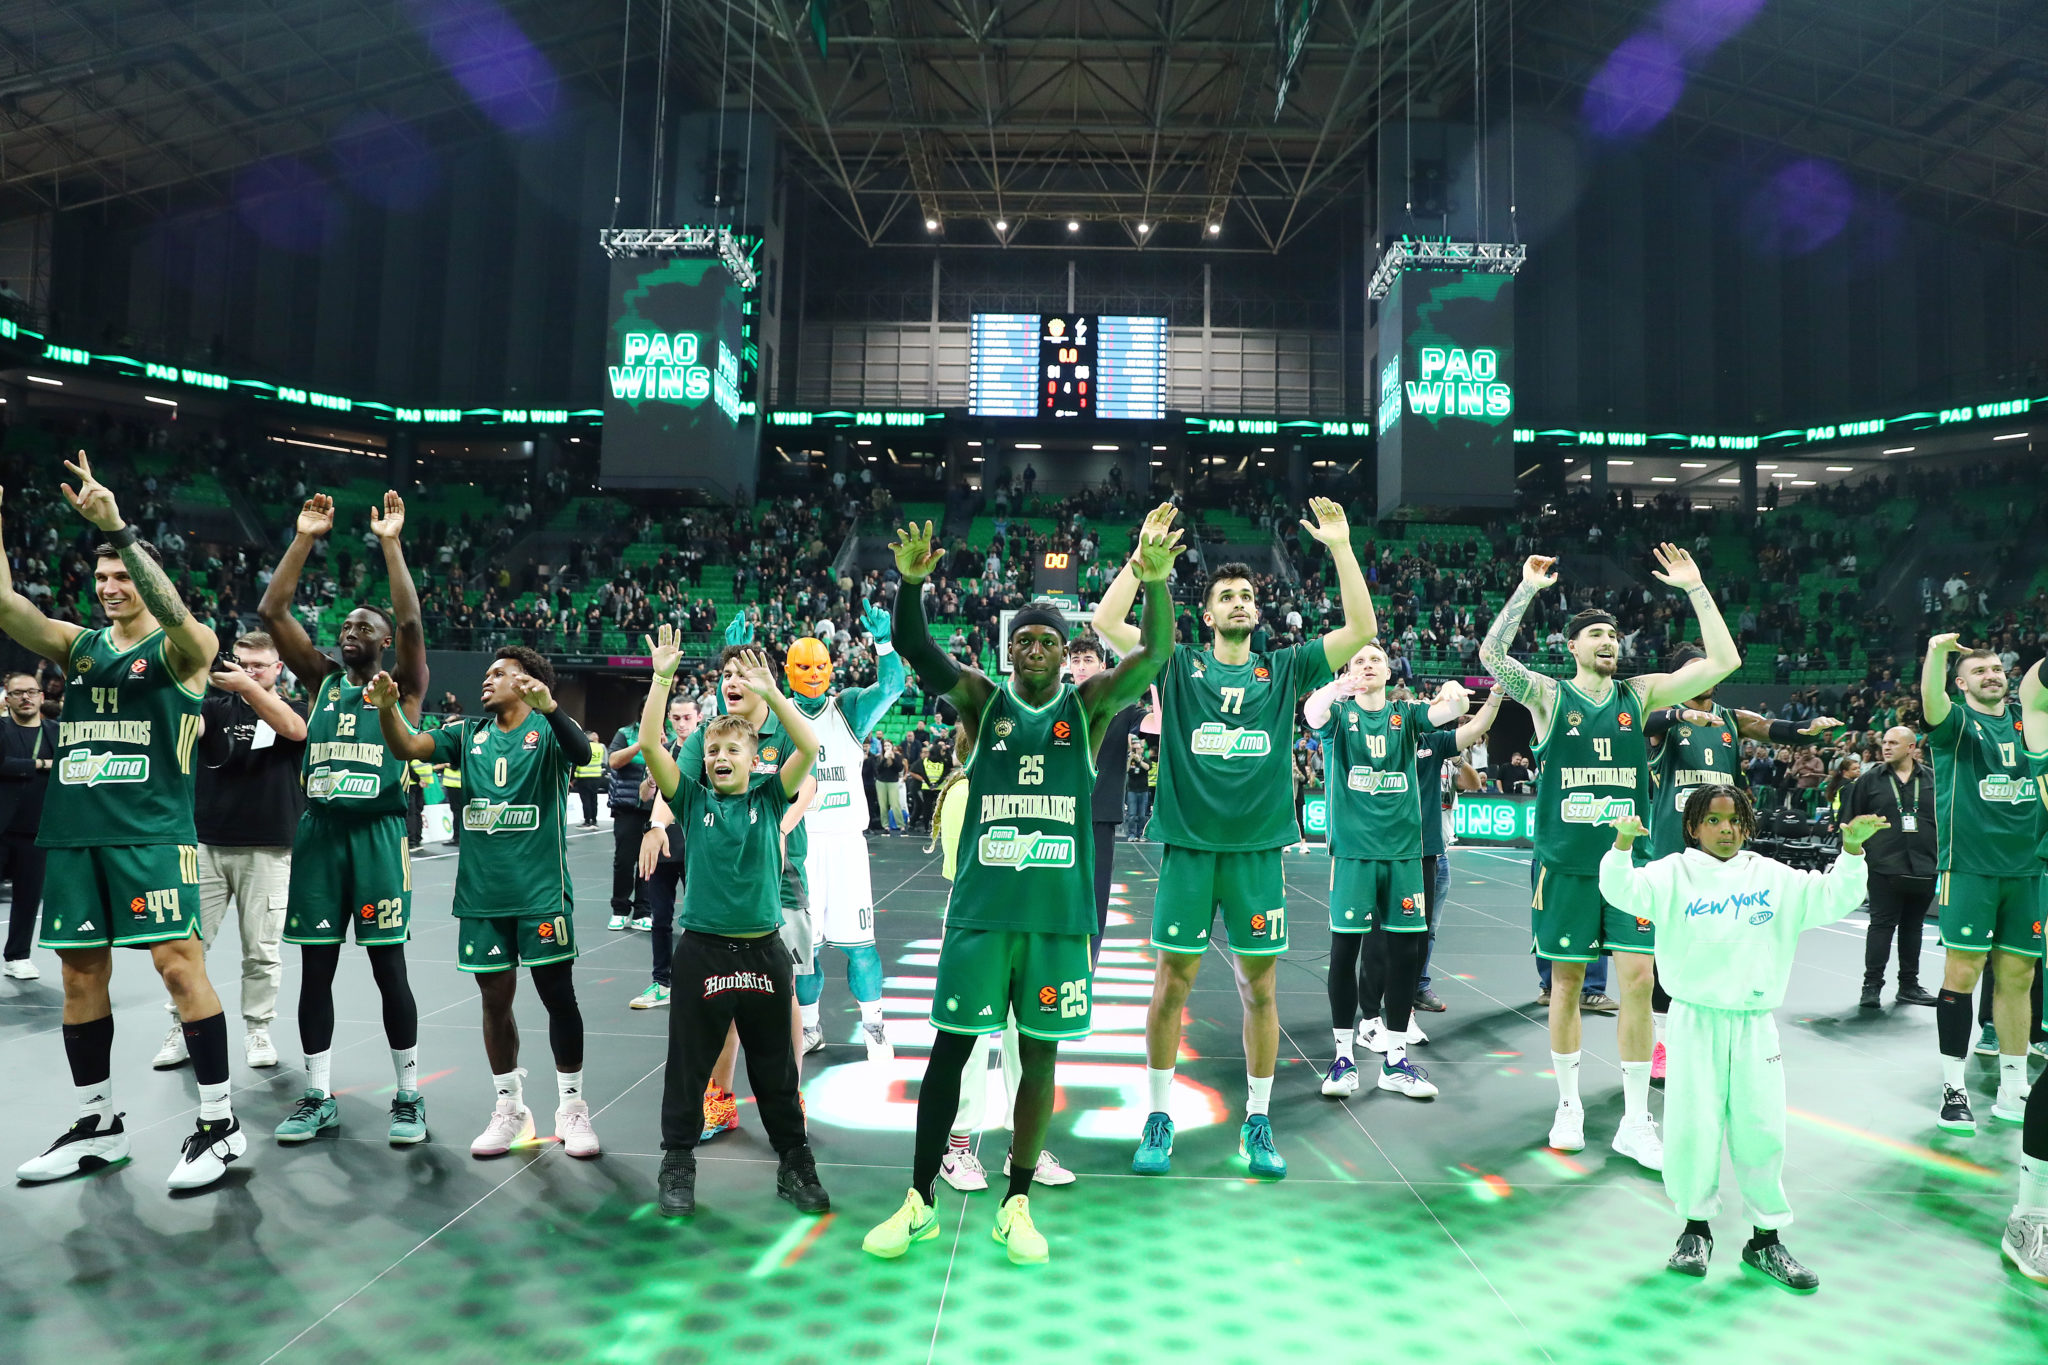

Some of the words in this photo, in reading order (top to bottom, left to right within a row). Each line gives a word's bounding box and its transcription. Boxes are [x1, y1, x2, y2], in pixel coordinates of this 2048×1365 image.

[625, 333, 698, 366] PAO
[145, 363, 178, 381] PAO
[1422, 348, 1496, 381] PAO
[277, 386, 307, 404] PAO
[608, 366, 710, 399] WINS
[1405, 381, 1511, 416] WINS
[395, 407, 421, 422] PAO
[502, 410, 528, 423] PAO
[856, 412, 882, 426] PAO
[1209, 420, 1235, 433] PAO
[1939, 406, 1973, 425] PAO
[1322, 422, 1349, 435] PAO
[1579, 431, 1605, 445] PAO
[1806, 425, 1836, 441] PAO
[1690, 435, 1716, 448] PAO
[1044, 552, 1069, 569] 00
[92, 687, 119, 713] 44
[1220, 686, 1245, 715] 77
[336, 712, 356, 737] 22
[819, 745, 826, 763] 8
[1365, 734, 1387, 759] 40
[1593, 738, 1612, 761] 41
[1704, 747, 1714, 766] 8
[494, 756, 508, 787] 0
[1018, 754, 1045, 785] 25
[703, 812, 715, 827] 41
[980, 794, 1076, 825] PANATHINAIKOS
[1453, 803, 1515, 836] INS
[146, 888, 182, 923] 44
[378, 897, 403, 929] 22
[554, 916, 568, 946] 0
[1266, 907, 1285, 941] 77
[703, 971, 775, 999] HoodRich
[1060, 978, 1088, 1018] 25
